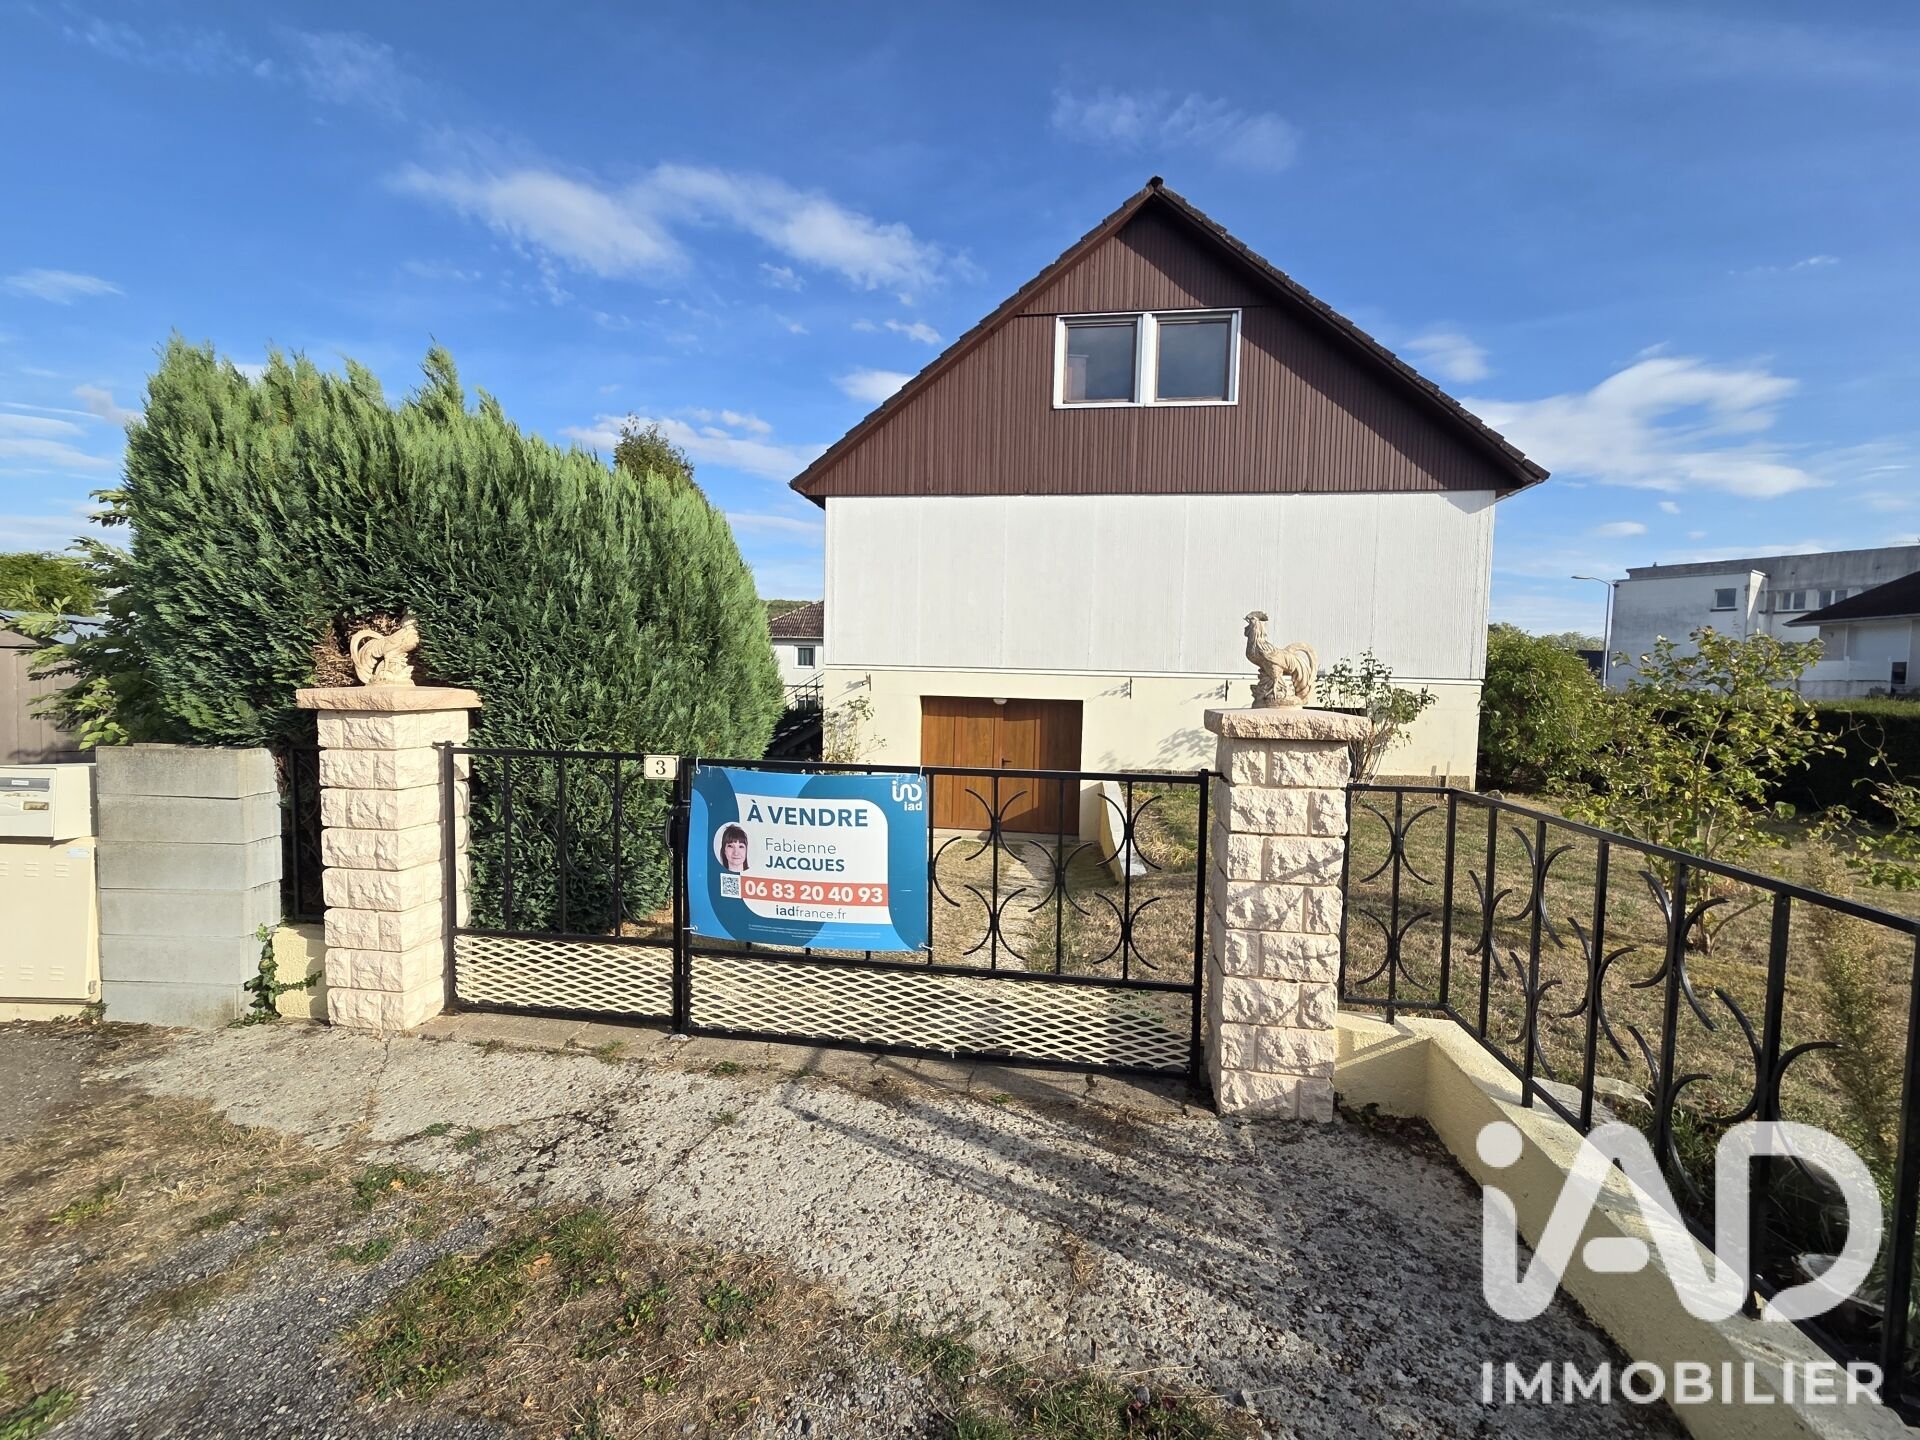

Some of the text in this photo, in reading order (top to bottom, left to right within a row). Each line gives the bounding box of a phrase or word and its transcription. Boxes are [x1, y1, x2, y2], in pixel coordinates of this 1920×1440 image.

[655, 760, 666, 775] 3
[747, 800, 868, 828] À VENDRE
[903, 801, 923, 812] iad
[765, 837, 837, 855] Fabienne
[765, 855, 845, 873] JACQUES
[745, 880, 883, 903] 06 83 20 40 93
[775, 904, 847, 921] iadfrance.fr
